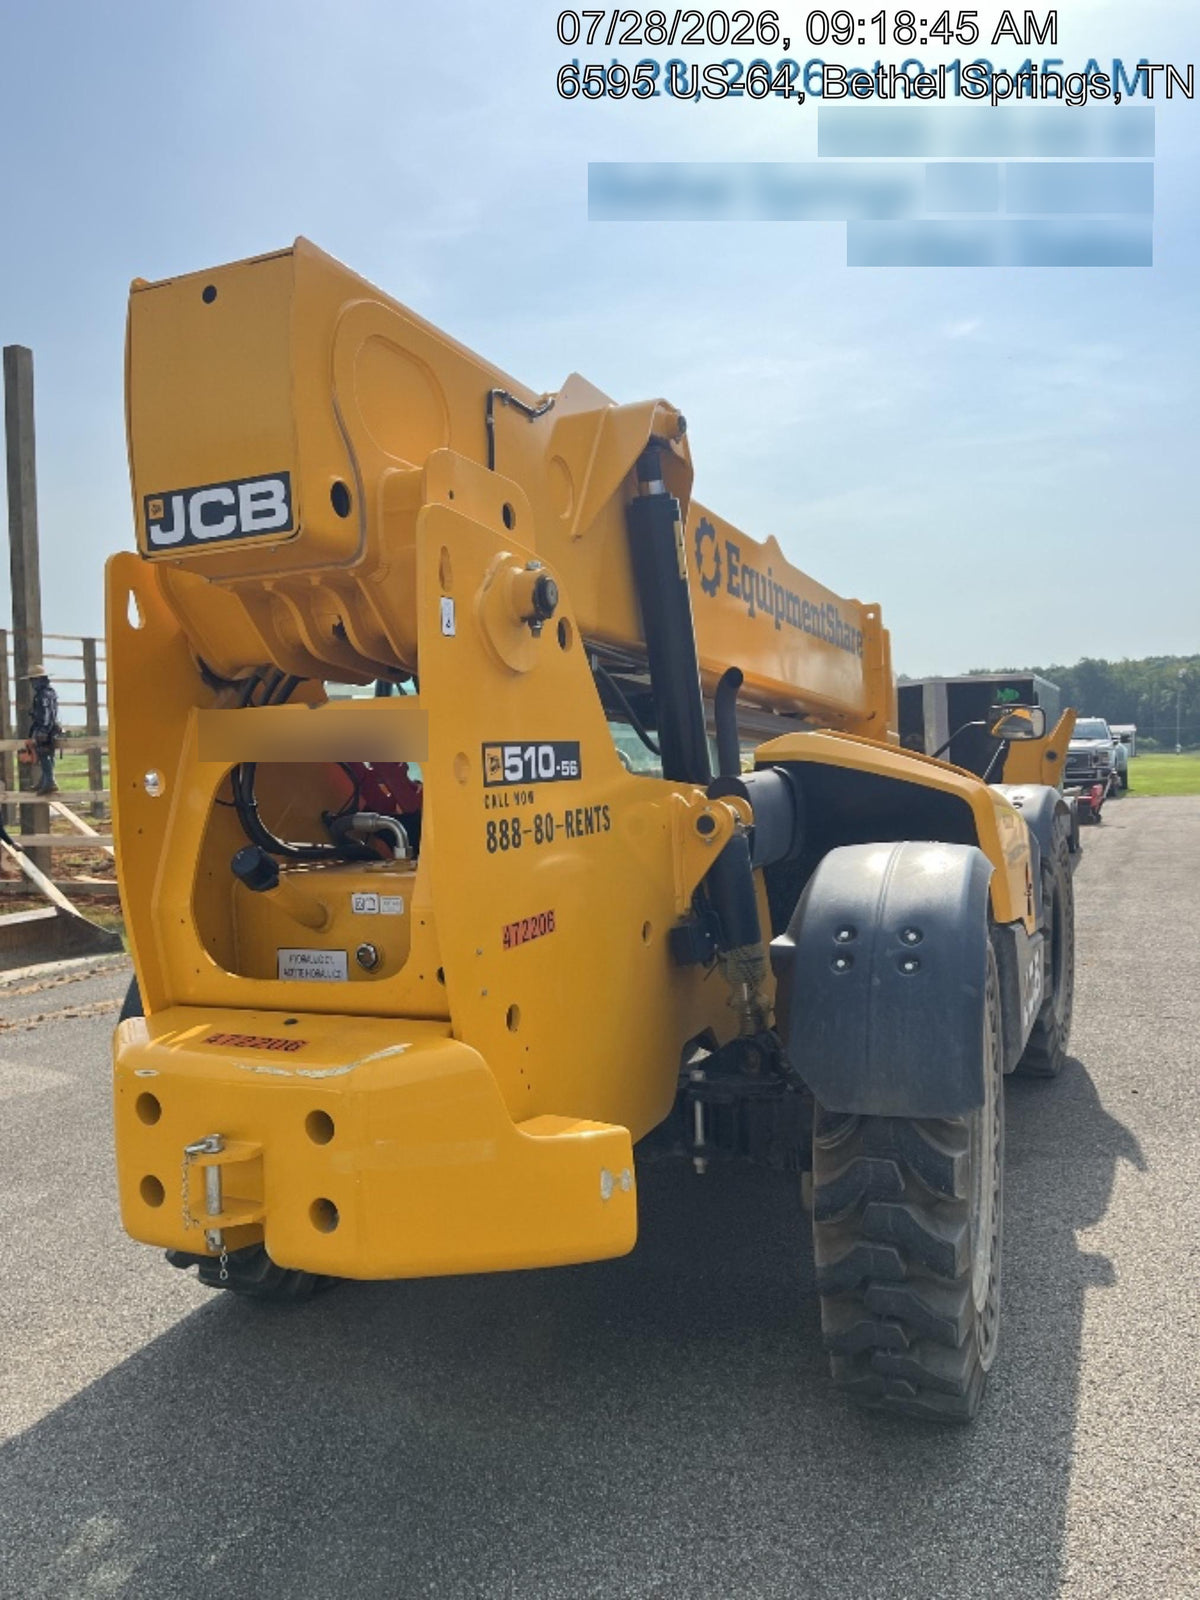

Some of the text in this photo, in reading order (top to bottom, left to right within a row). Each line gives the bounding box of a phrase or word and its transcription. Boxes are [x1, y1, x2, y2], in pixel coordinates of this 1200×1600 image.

[150, 479, 289, 545] JCB
[725, 540, 864, 658] EquipmentShare
[484, 791, 510, 809] CALL
[486, 805, 611, 854] 888-80-RENTS
[503, 909, 555, 949] 472206
